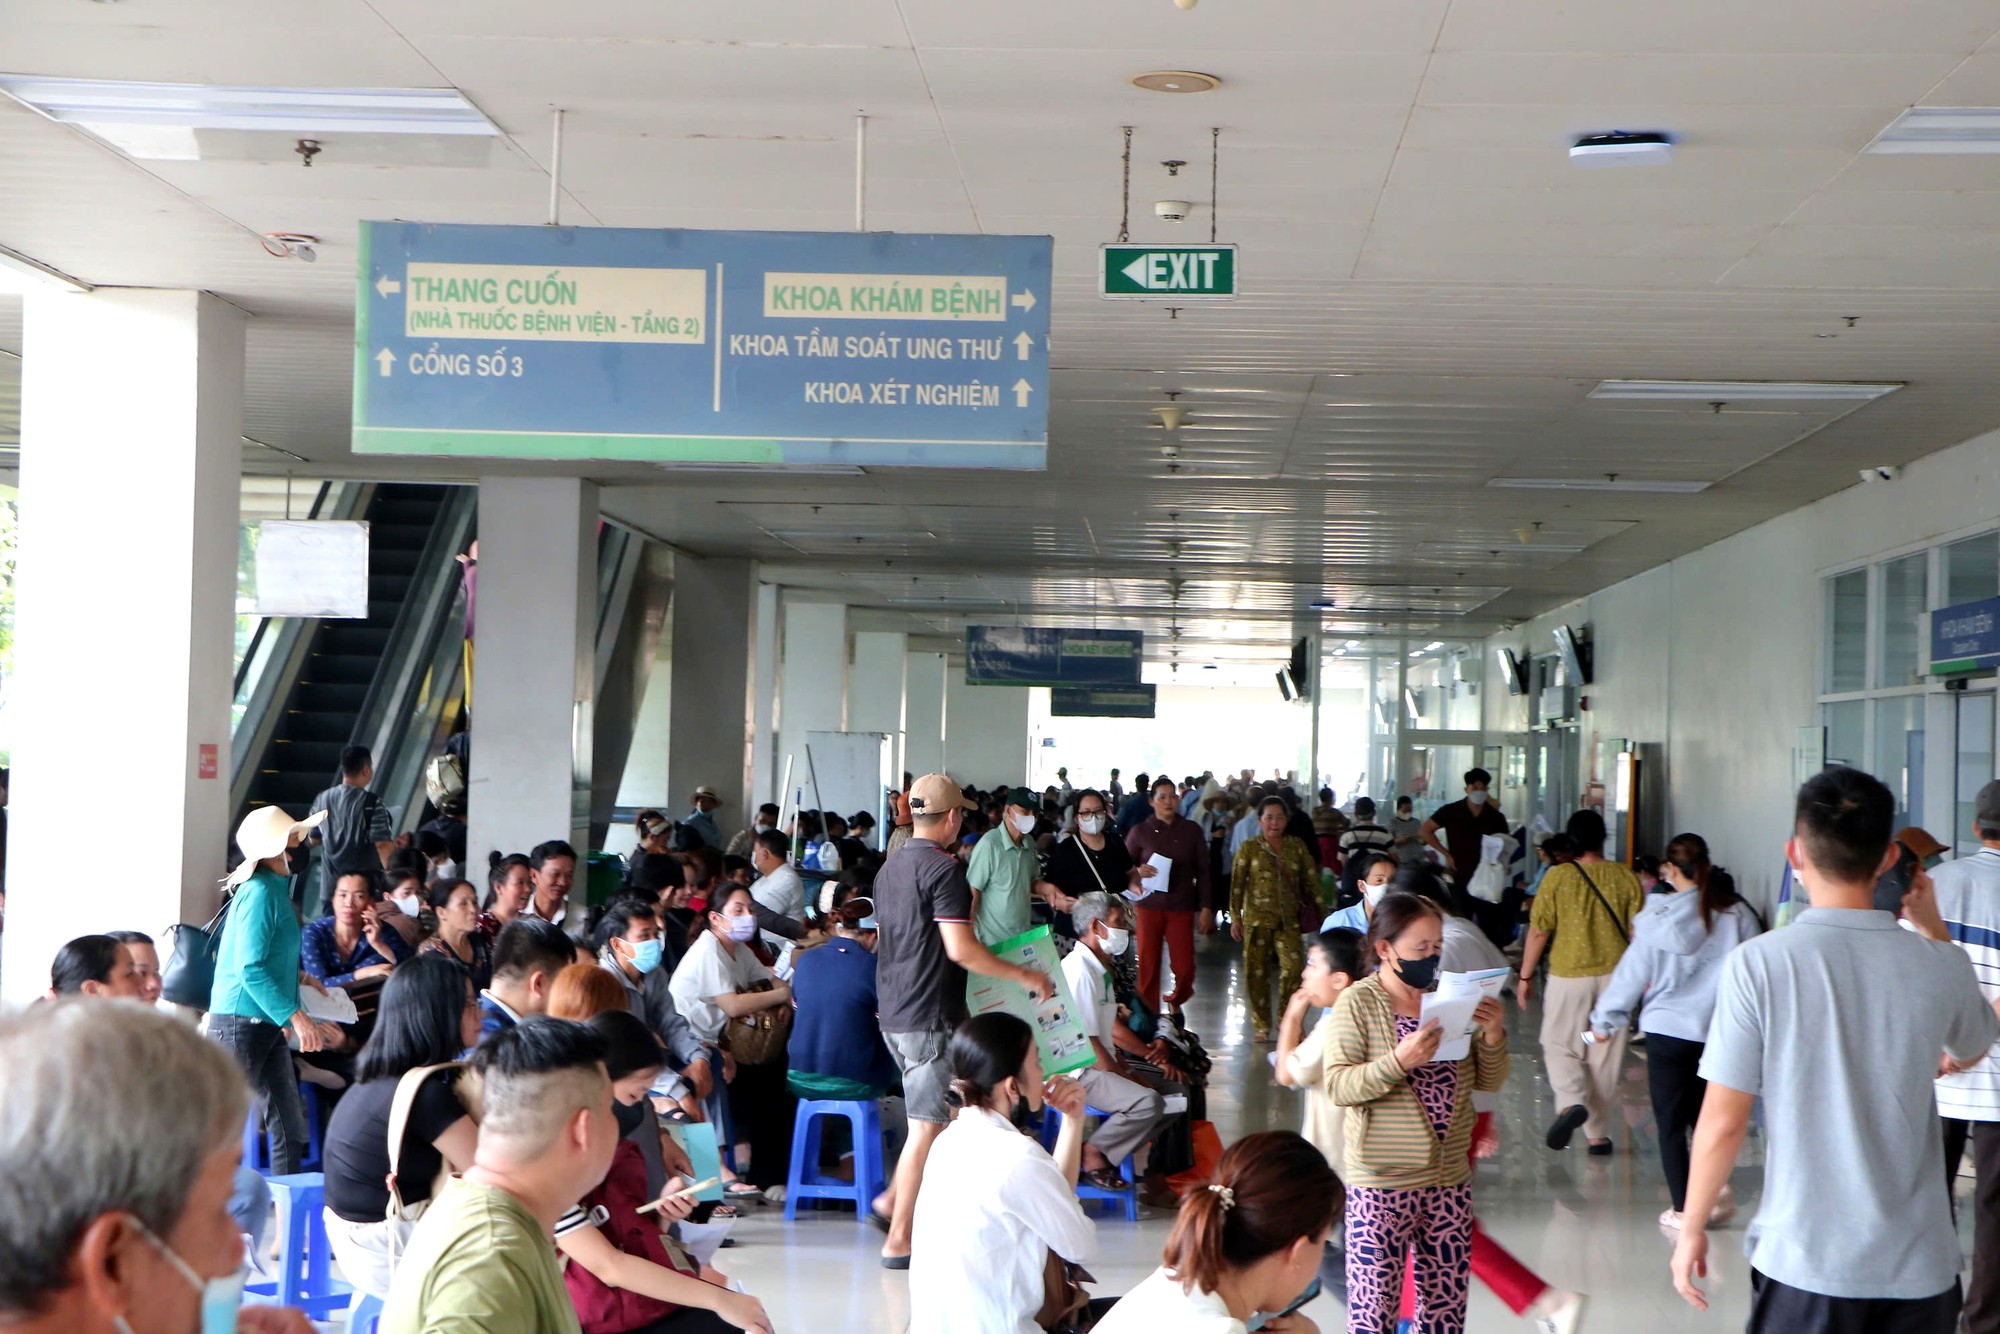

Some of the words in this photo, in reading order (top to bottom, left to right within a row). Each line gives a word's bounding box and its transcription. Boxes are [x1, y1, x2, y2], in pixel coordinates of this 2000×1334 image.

[410, 277, 499, 304] THANG
[506, 269, 577, 306] CUỐN
[1148, 252, 1220, 290] EXIT
[771, 284, 843, 312] KHOA
[849, 280, 923, 314] KHÁM
[930, 281, 1002, 320] BỆNH
[410, 307, 453, 332] (NHÀ
[456, 306, 516, 332] THUỐC
[523, 311, 571, 335] BỆNH
[577, 310, 616, 338] VIỆN
[684, 318, 700, 338] 2)
[408, 341, 471, 376] CỔNG
[475, 344, 509, 376] SỐ
[511, 356, 524, 377] 3
[728, 334, 790, 356] KHOA
[794, 326, 838, 358] TẦM
[844, 330, 901, 359] SOÁT
[906, 337, 953, 360] UNG
[957, 336, 1004, 362] THƯ
[805, 382, 865, 405] KHOA
[869, 378, 914, 405] XÉT
[916, 379, 1000, 410] NGHIỆM
